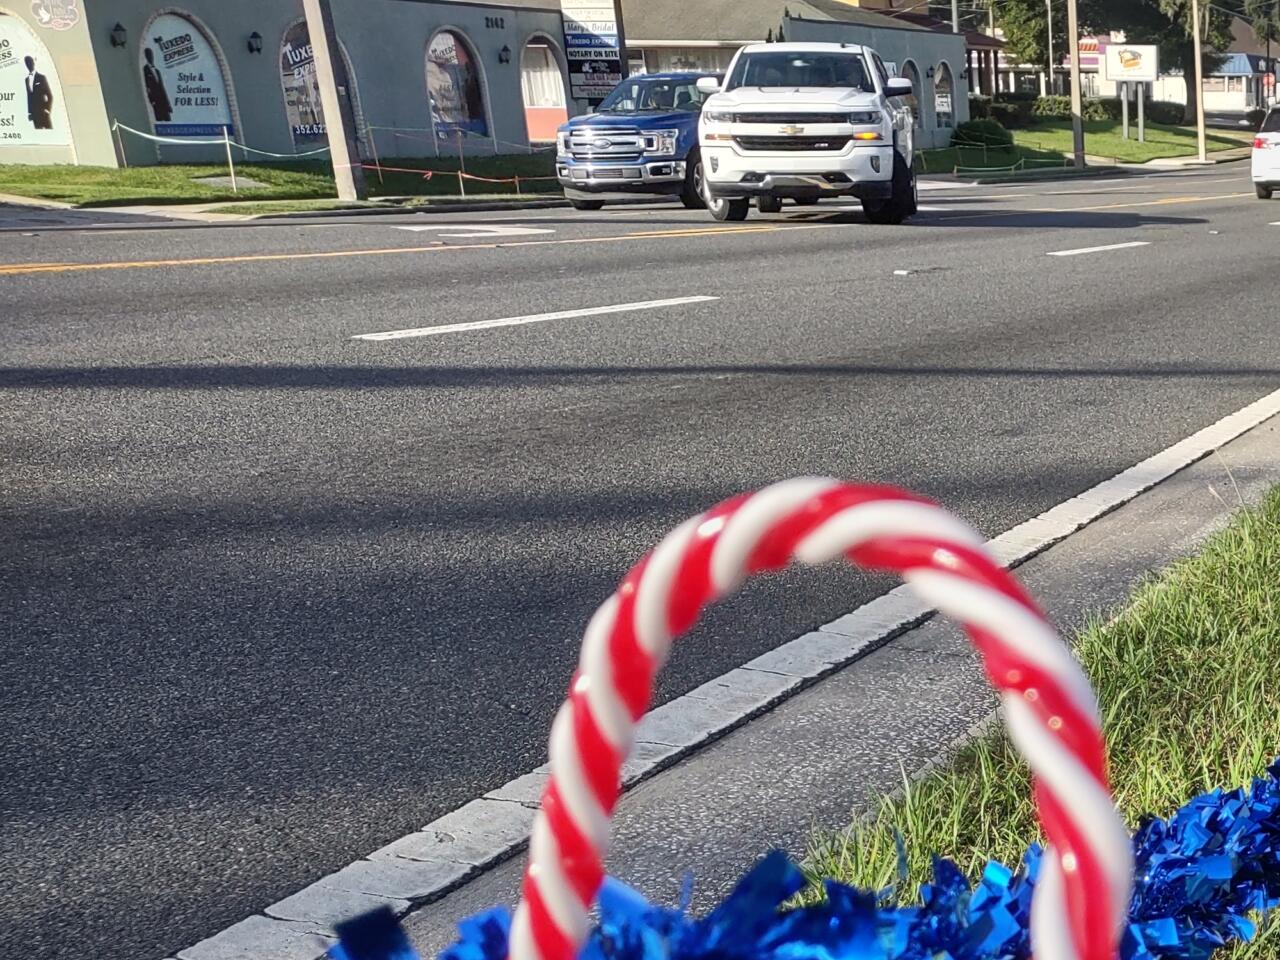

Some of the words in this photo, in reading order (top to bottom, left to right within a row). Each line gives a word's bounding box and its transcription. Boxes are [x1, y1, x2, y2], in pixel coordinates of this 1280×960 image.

[591, 23, 614, 31] Bridal
[153, 33, 192, 52] TUXEDO
[163, 44, 194, 62] EXPRESS
[568, 50, 592, 58] NOTARY
[604, 50, 619, 58] SITE
[177, 73, 197, 83] Style
[198, 73, 205, 81] &
[176, 85, 211, 94] Selection
[174, 97, 192, 106] FOR
[194, 97, 219, 107] LESS!
